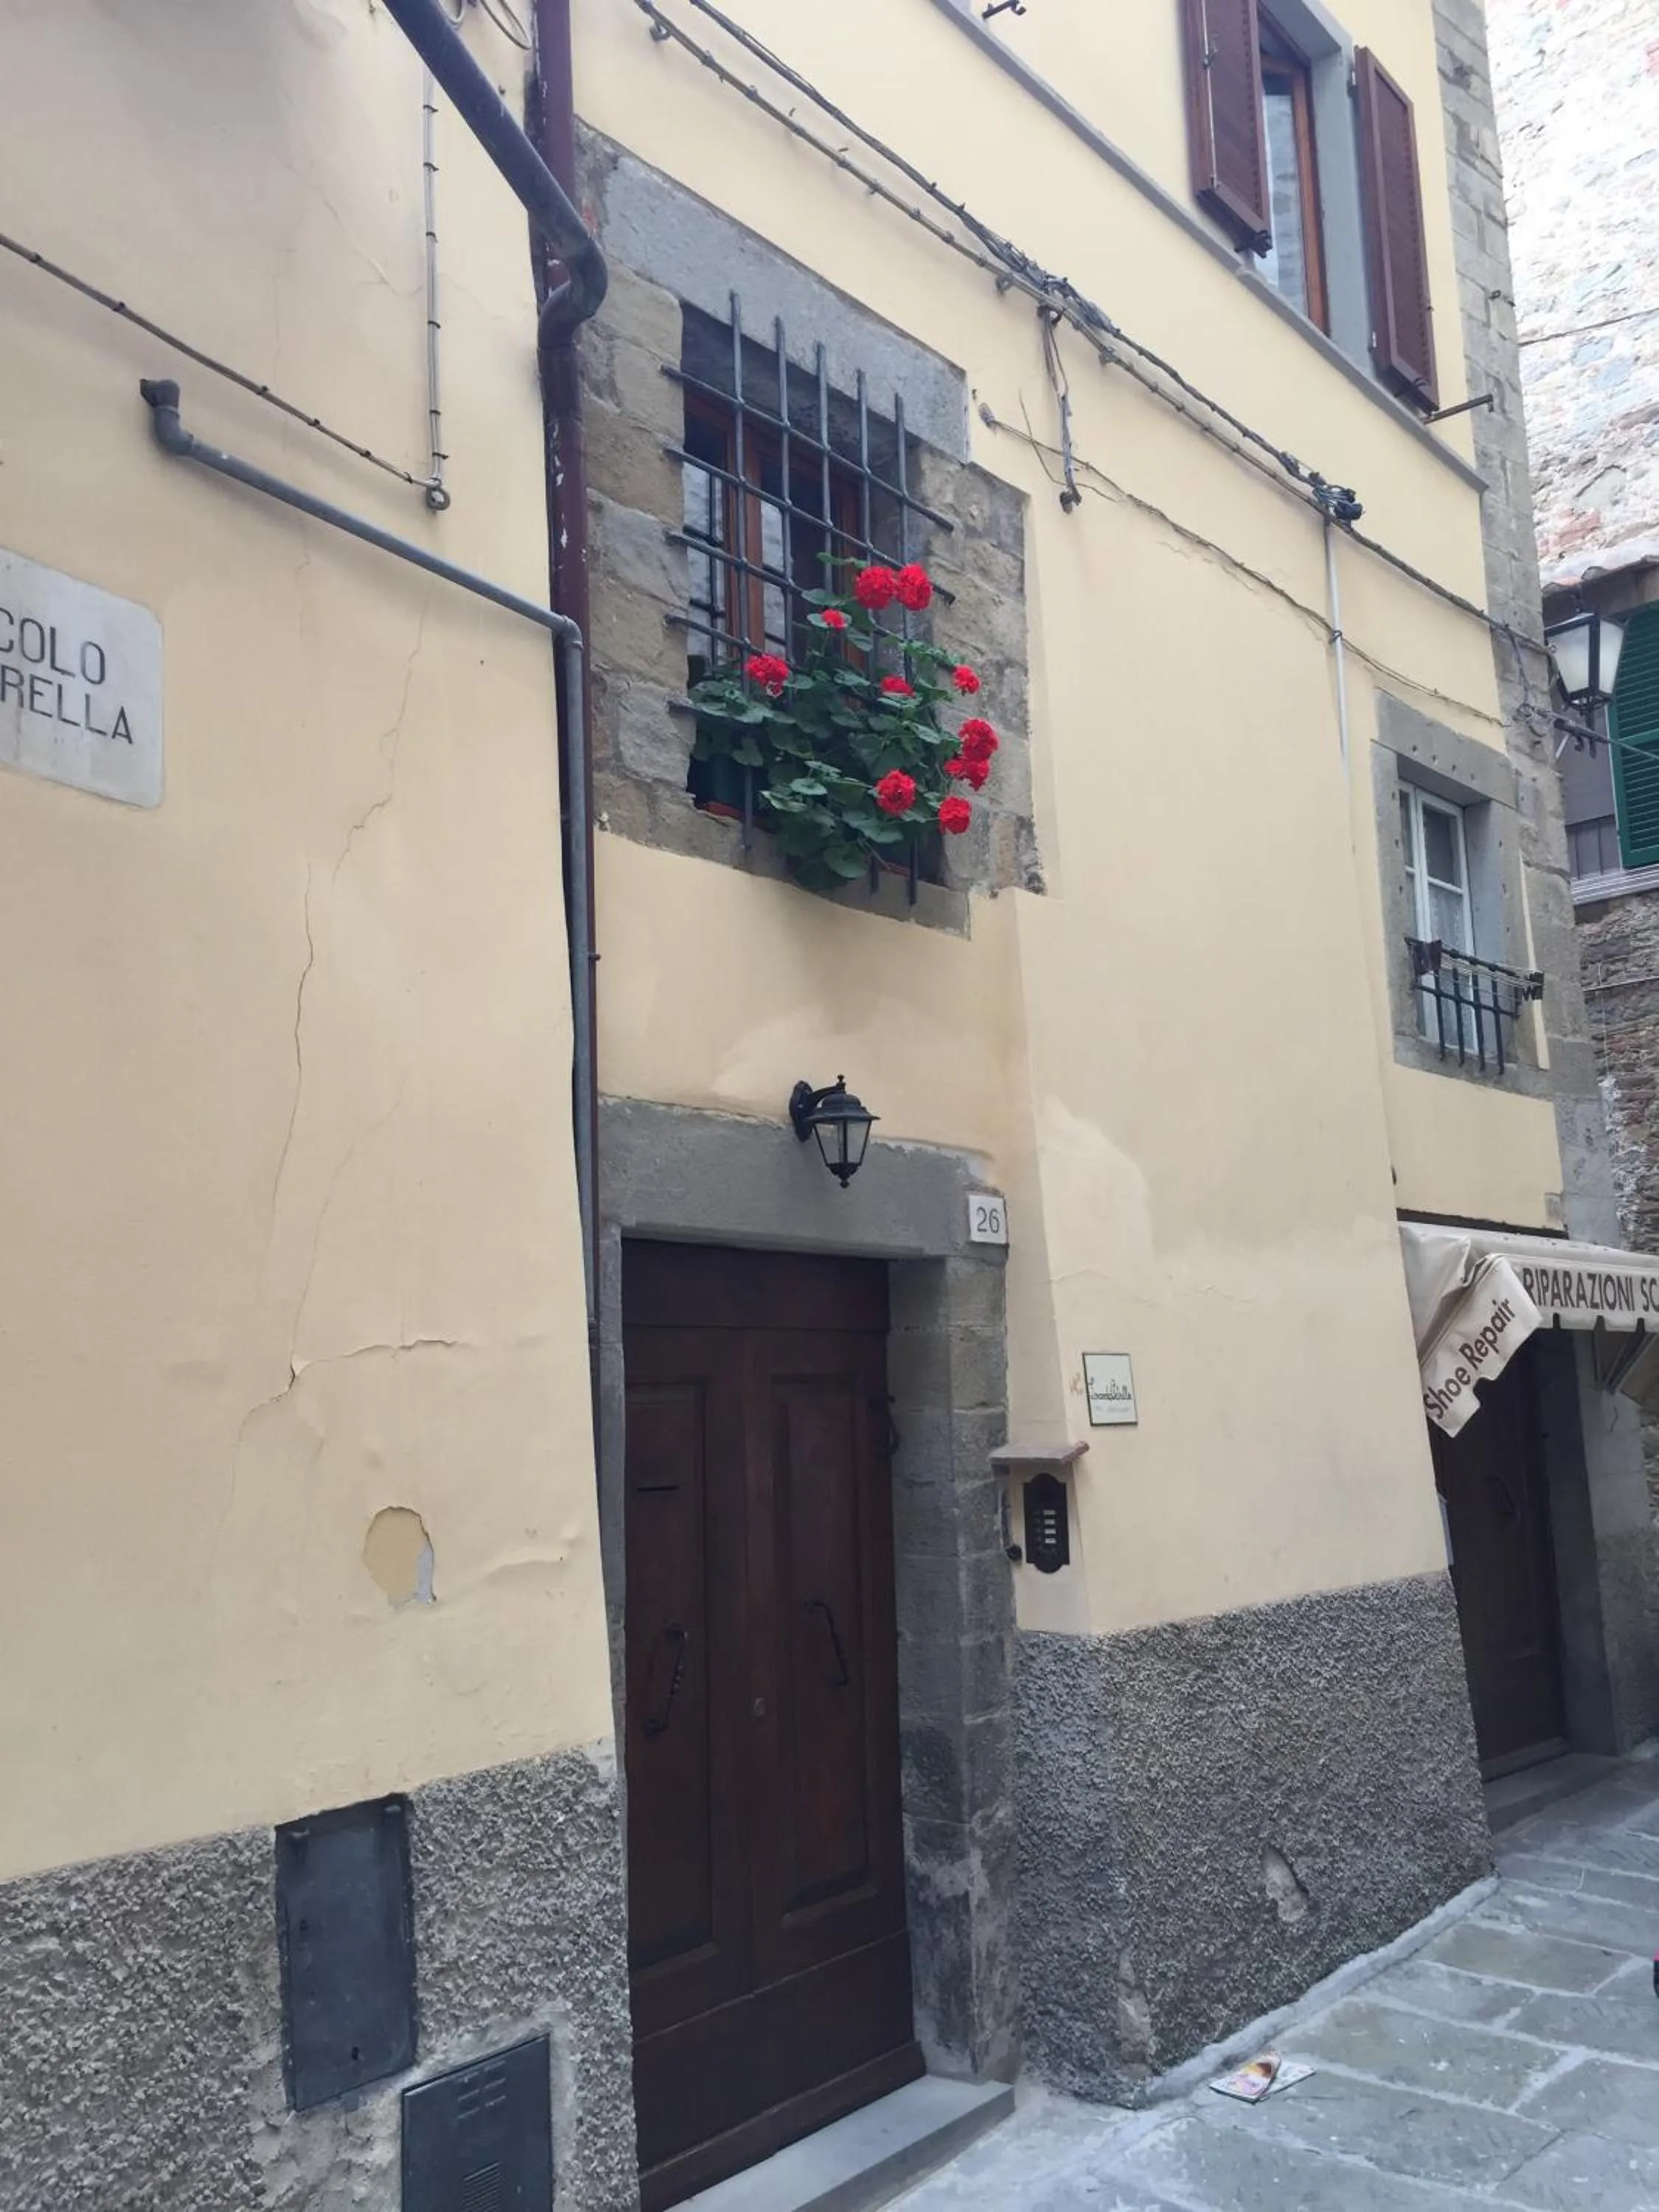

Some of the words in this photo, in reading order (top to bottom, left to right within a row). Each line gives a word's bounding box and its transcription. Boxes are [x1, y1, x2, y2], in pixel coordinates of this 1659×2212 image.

[1, 664, 133, 745] RELLA
[975, 1206, 1001, 1234] 26
[1523, 1267, 1635, 1311] RIPARAZIONI
[1422, 1366, 1471, 1420] Shoe
[1458, 1298, 1515, 1371] Repair
